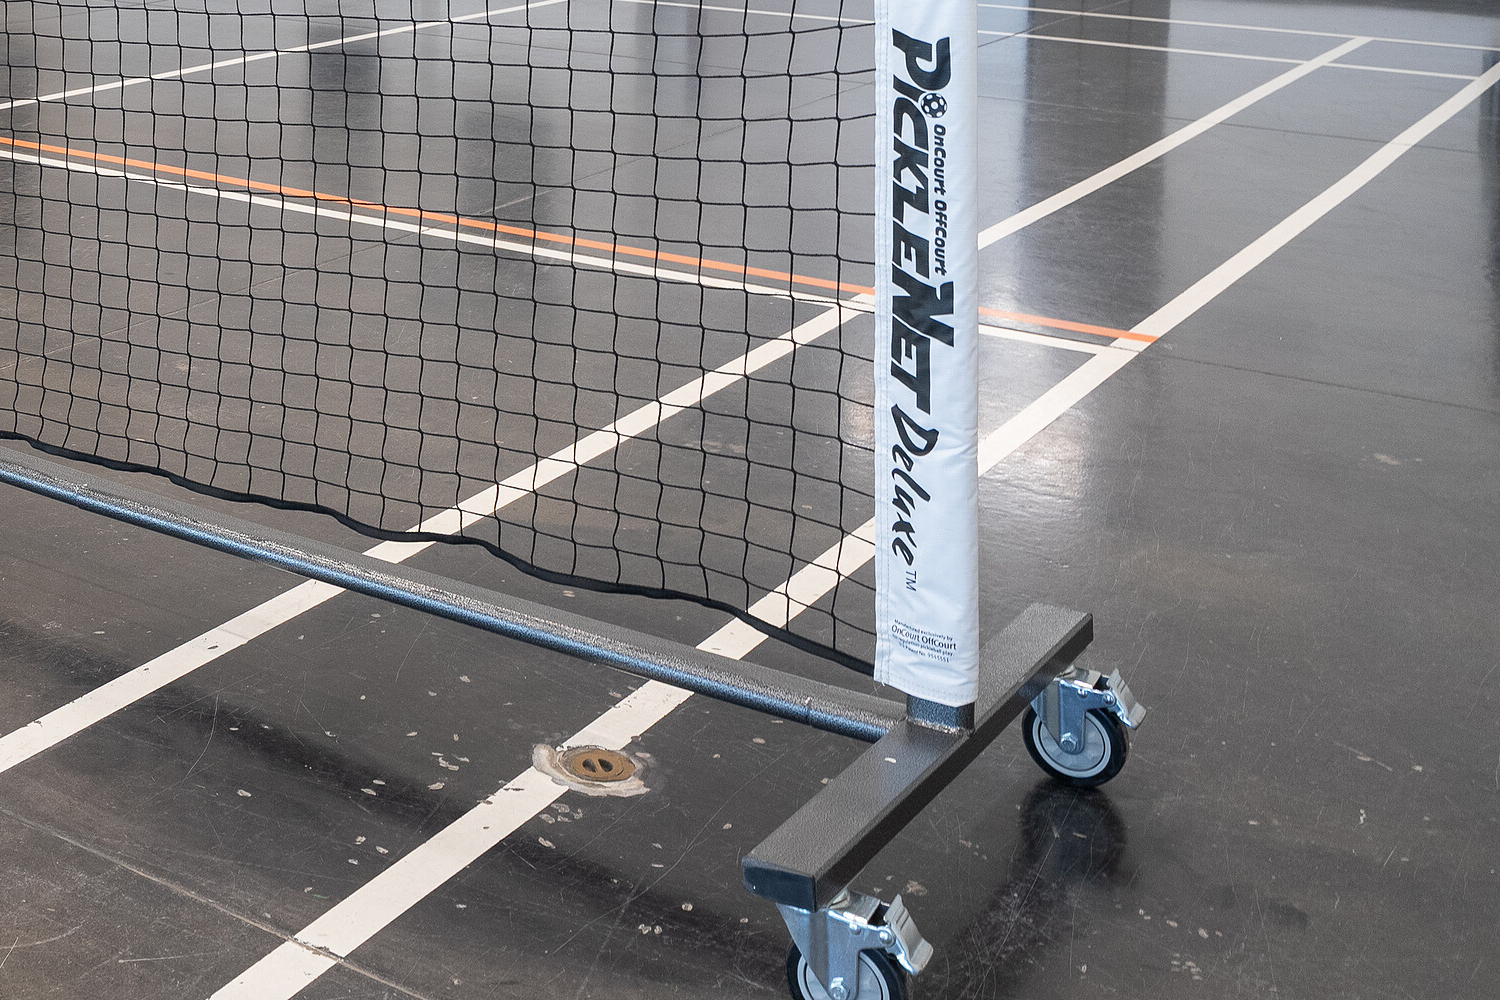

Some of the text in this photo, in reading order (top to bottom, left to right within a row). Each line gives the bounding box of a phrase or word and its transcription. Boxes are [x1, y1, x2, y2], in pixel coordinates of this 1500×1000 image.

[891, 28, 954, 415] PICKLENET
[891, 403, 940, 566] Deluxe
[891, 624, 957, 650] OnCourt OffCourt
[894, 618, 920, 633] Manufactured
[920, 630, 946, 640] exclusively
[920, 644, 942, 653] pickleball
